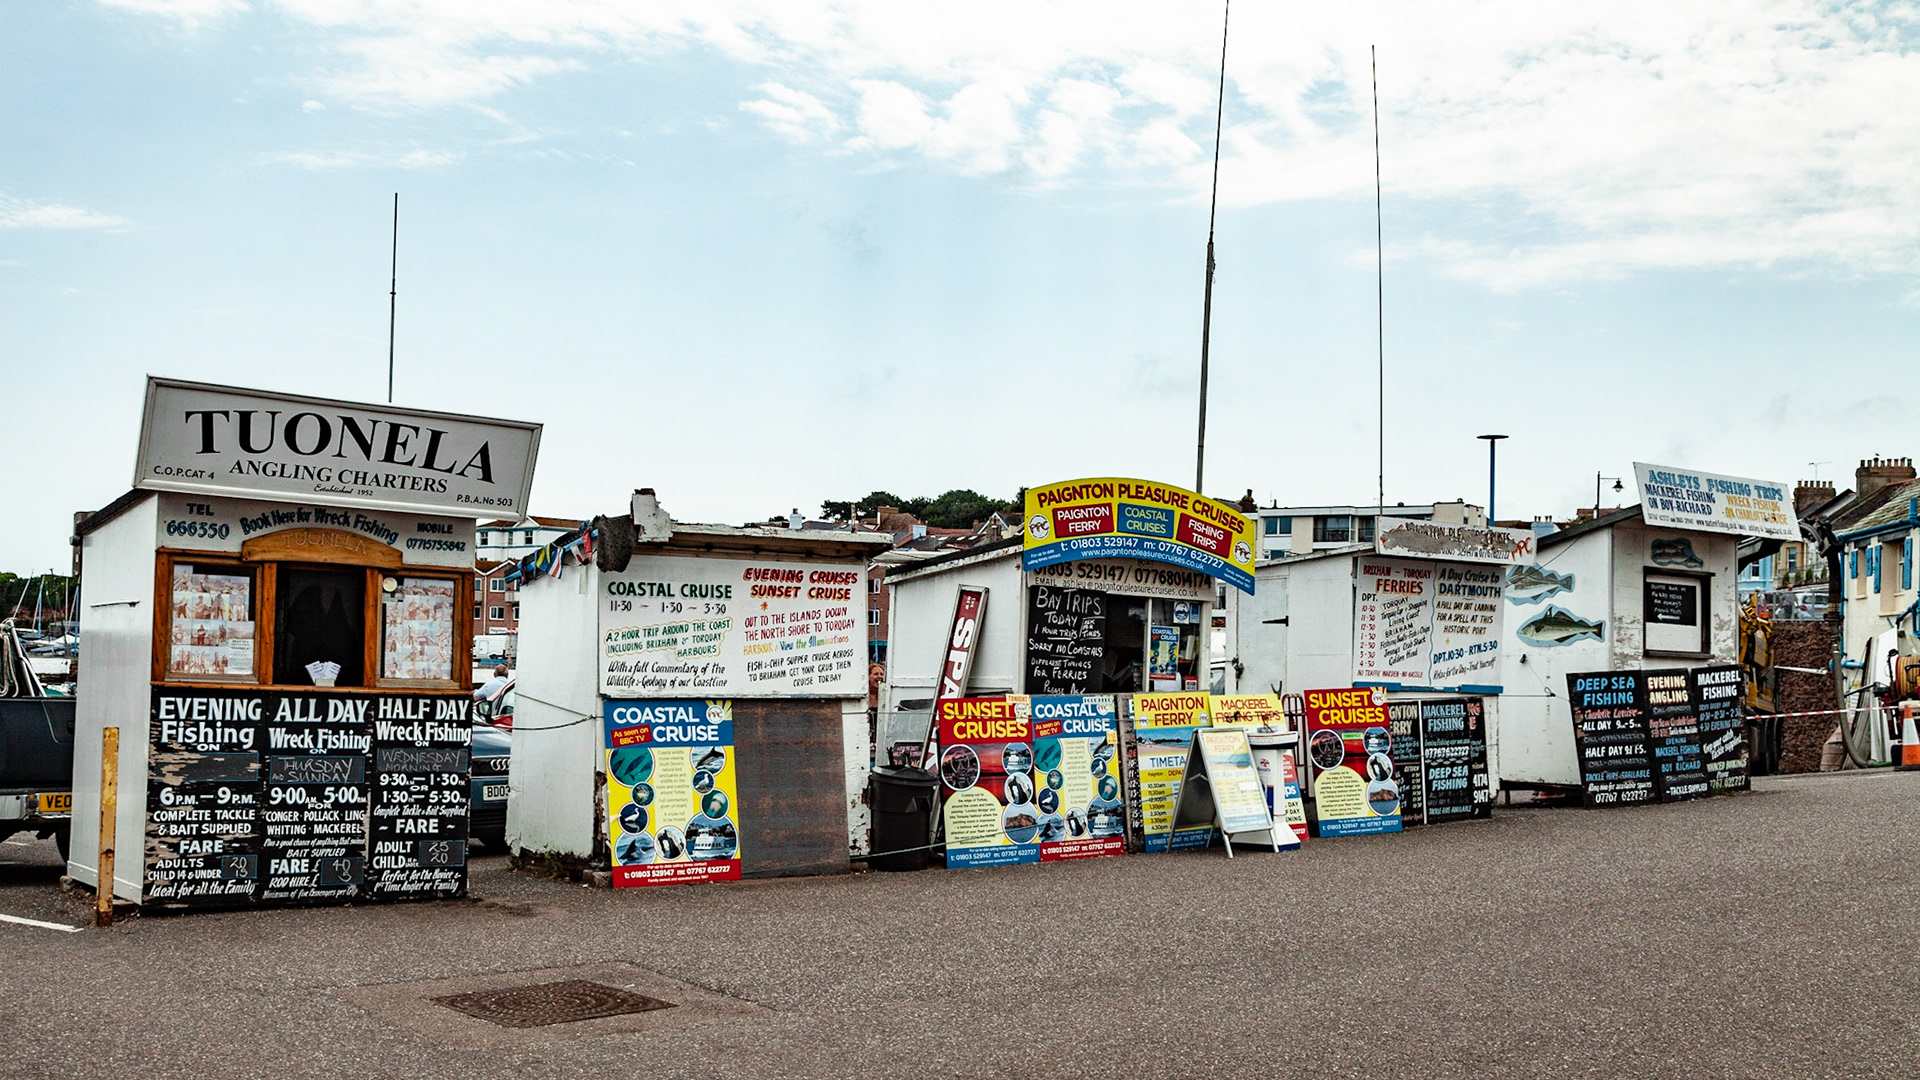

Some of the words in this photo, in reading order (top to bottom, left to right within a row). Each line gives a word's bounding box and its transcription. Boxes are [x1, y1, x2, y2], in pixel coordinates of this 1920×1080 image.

[185, 410, 495, 484] TUONELA
[229, 459, 332, 483] ANGLING
[338, 469, 448, 493] CHARTERS
[1648, 469, 1701, 490] ASHLEYS
[1706, 478, 1751, 497] FISHING
[1754, 485, 1783, 502] TRIPS
[1645, 483, 1686, 500] MACKEREL
[1687, 490, 1716, 504] FISHING
[497, 498, 513, 507] 503
[1037, 483, 1114, 508] PAIGNTON
[1118, 483, 1189, 509] PLEASURE
[1192, 499, 1245, 534] CRUISES
[1676, 502, 1712, 516] RICHARD
[1726, 495, 1752, 508] WRECK
[187, 503, 214, 516] TEL
[1057, 506, 1110, 521] PAIGNTON
[1125, 507, 1168, 521] COASTAL
[167, 520, 230, 539] 666350
[240, 513, 271, 535] Book
[271, 509, 296, 526] Here
[315, 508, 351, 527] Wreck
[353, 514, 400, 545] Fishing
[417, 522, 453, 534] MOBILE
[1069, 520, 1101, 533] FERRY
[1126, 520, 1166, 533] CRUISES
[1188, 520, 1224, 540] FISHING
[1192, 533, 1217, 550] TRIPS
[1071, 538, 1101, 549] 01803
[1104, 538, 1138, 547] 529147
[1158, 542, 1188, 556] 07767
[1190, 550, 1224, 568] 622727
[743, 567, 803, 583] EVENING
[809, 570, 858, 585] CRUISES
[1077, 562, 1124, 581] 529147
[1363, 565, 1391, 577] BRIXHAM
[1403, 568, 1433, 579] TORQUAY
[1448, 569, 1463, 583] Day
[1464, 570, 1489, 582] Cruise
[1491, 572, 1500, 582] to
[1035, 577, 1057, 586] EMAIL
[1376, 579, 1424, 594] FERRIES
[608, 582, 675, 599] COASTAL
[680, 584, 732, 599] CRUISE
[750, 584, 800, 599] SUNSET
[808, 587, 852, 601] CRUISE
[1439, 582, 1501, 597] DARTMOUTH
[1382, 596, 1409, 611] TORQUAY
[744, 617, 759, 628] OUT
[760, 616, 769, 626] TO
[771, 614, 785, 625] THE
[789, 610, 822, 623] ISLANDS
[825, 607, 848, 618] DOWN
[1044, 611, 1077, 627] TODAY
[605, 631, 614, 642] A
[621, 628, 641, 640] HOUR
[643, 627, 659, 638] TRIP
[662, 624, 690, 635] AROUND
[693, 622, 707, 632] THE
[709, 619, 731, 631] COAST
[745, 631, 759, 642] THE
[761, 627, 785, 640] NORTH
[788, 624, 812, 636] SHORE
[814, 623, 824, 633] TO
[825, 618, 855, 632] TORQUAY
[608, 641, 643, 654] INCLUDING
[646, 637, 678, 648] BRIXHAM
[692, 633, 722, 644] TORQUAY
[1028, 638, 1053, 651] SORRY
[1068, 641, 1103, 657] COASTALS
[677, 646, 717, 658] HARBOURS
[1052, 667, 1087, 680] FERRIES
[1698, 671, 1741, 686] MACKEREL
[1577, 678, 1608, 691] DEEP
[1611, 676, 1635, 689] SEA
[1647, 675, 1686, 690] EVENING
[1309, 691, 1370, 709] SUNSET
[1583, 692, 1634, 706] FISHING
[1650, 690, 1689, 704] ANGLING
[1703, 685, 1737, 700] FISHING
[159, 698, 262, 721] EVENING
[273, 698, 323, 722] ALL
[325, 700, 371, 723] DAY
[378, 698, 432, 720] HALF
[435, 699, 470, 721] DAY
[943, 702, 1011, 720] SUNSET
[1035, 703, 1096, 718] COASTAL
[1141, 697, 1204, 711] PAIGNTON
[1220, 699, 1272, 710] MACKEREL
[1423, 704, 1466, 717] MACKEREL
[613, 707, 700, 724] COASTAL
[1154, 712, 1193, 726] FERRY
[1319, 708, 1385, 725] CRUISES
[954, 721, 1028, 739] CRUISES
[1063, 719, 1110, 733] CRUISE
[1428, 717, 1465, 732] FISHING
[1583, 722, 1595, 731] ALL
[1597, 720, 1612, 730] DAY
[161, 721, 255, 748] Fishing
[269, 728, 314, 750] Wreck
[317, 730, 371, 754] Fishing
[375, 721, 425, 742] Wreck
[424, 722, 472, 746] Fishing
[620, 736, 633, 745] BBC
[624, 729, 638, 737] seen
[652, 726, 719, 742] CRUISE
[382, 750, 460, 766] WEDNESDAY
[1585, 747, 1605, 758] HALF
[1608, 746, 1623, 756] DAY
[278, 757, 353, 773] THURSDAY
[1429, 768, 1450, 780] DEEP
[1452, 765, 1468, 777] SEA
[287, 772, 349, 784] SUNDAY
[1432, 778, 1468, 791] FISHING
[1595, 792, 1617, 803] 07767
[1622, 790, 1648, 802] 622727
[153, 810, 211, 822] COMPLETE
[215, 810, 255, 820] TACKLE
[266, 811, 299, 822] CONGER
[304, 811, 339, 822] POLLACK
[345, 810, 365, 821] LING
[170, 824, 198, 835] BAIT
[201, 823, 252, 834] SUPPLIED
[267, 825, 306, 835] WHITING
[313, 824, 361, 834] MACKEREL
[396, 818, 439, 833] FARE
[180, 840, 223, 854] FARE
[286, 849, 310, 857] BAIT
[311, 848, 346, 857] SUPPLIED
[374, 841, 413, 854] ADULT
[156, 858, 204, 868] ADULTS
[270, 859, 309, 874] FARE
[373, 856, 405, 869] CHILD
[148, 869, 175, 881] CHILD
[195, 870, 222, 878] UNDER
[269, 878, 289, 888] ROD
[289, 877, 310, 887] HIRE
[149, 882, 176, 897] Ideal
[177, 882, 194, 898] for
[225, 880, 255, 894] Family
